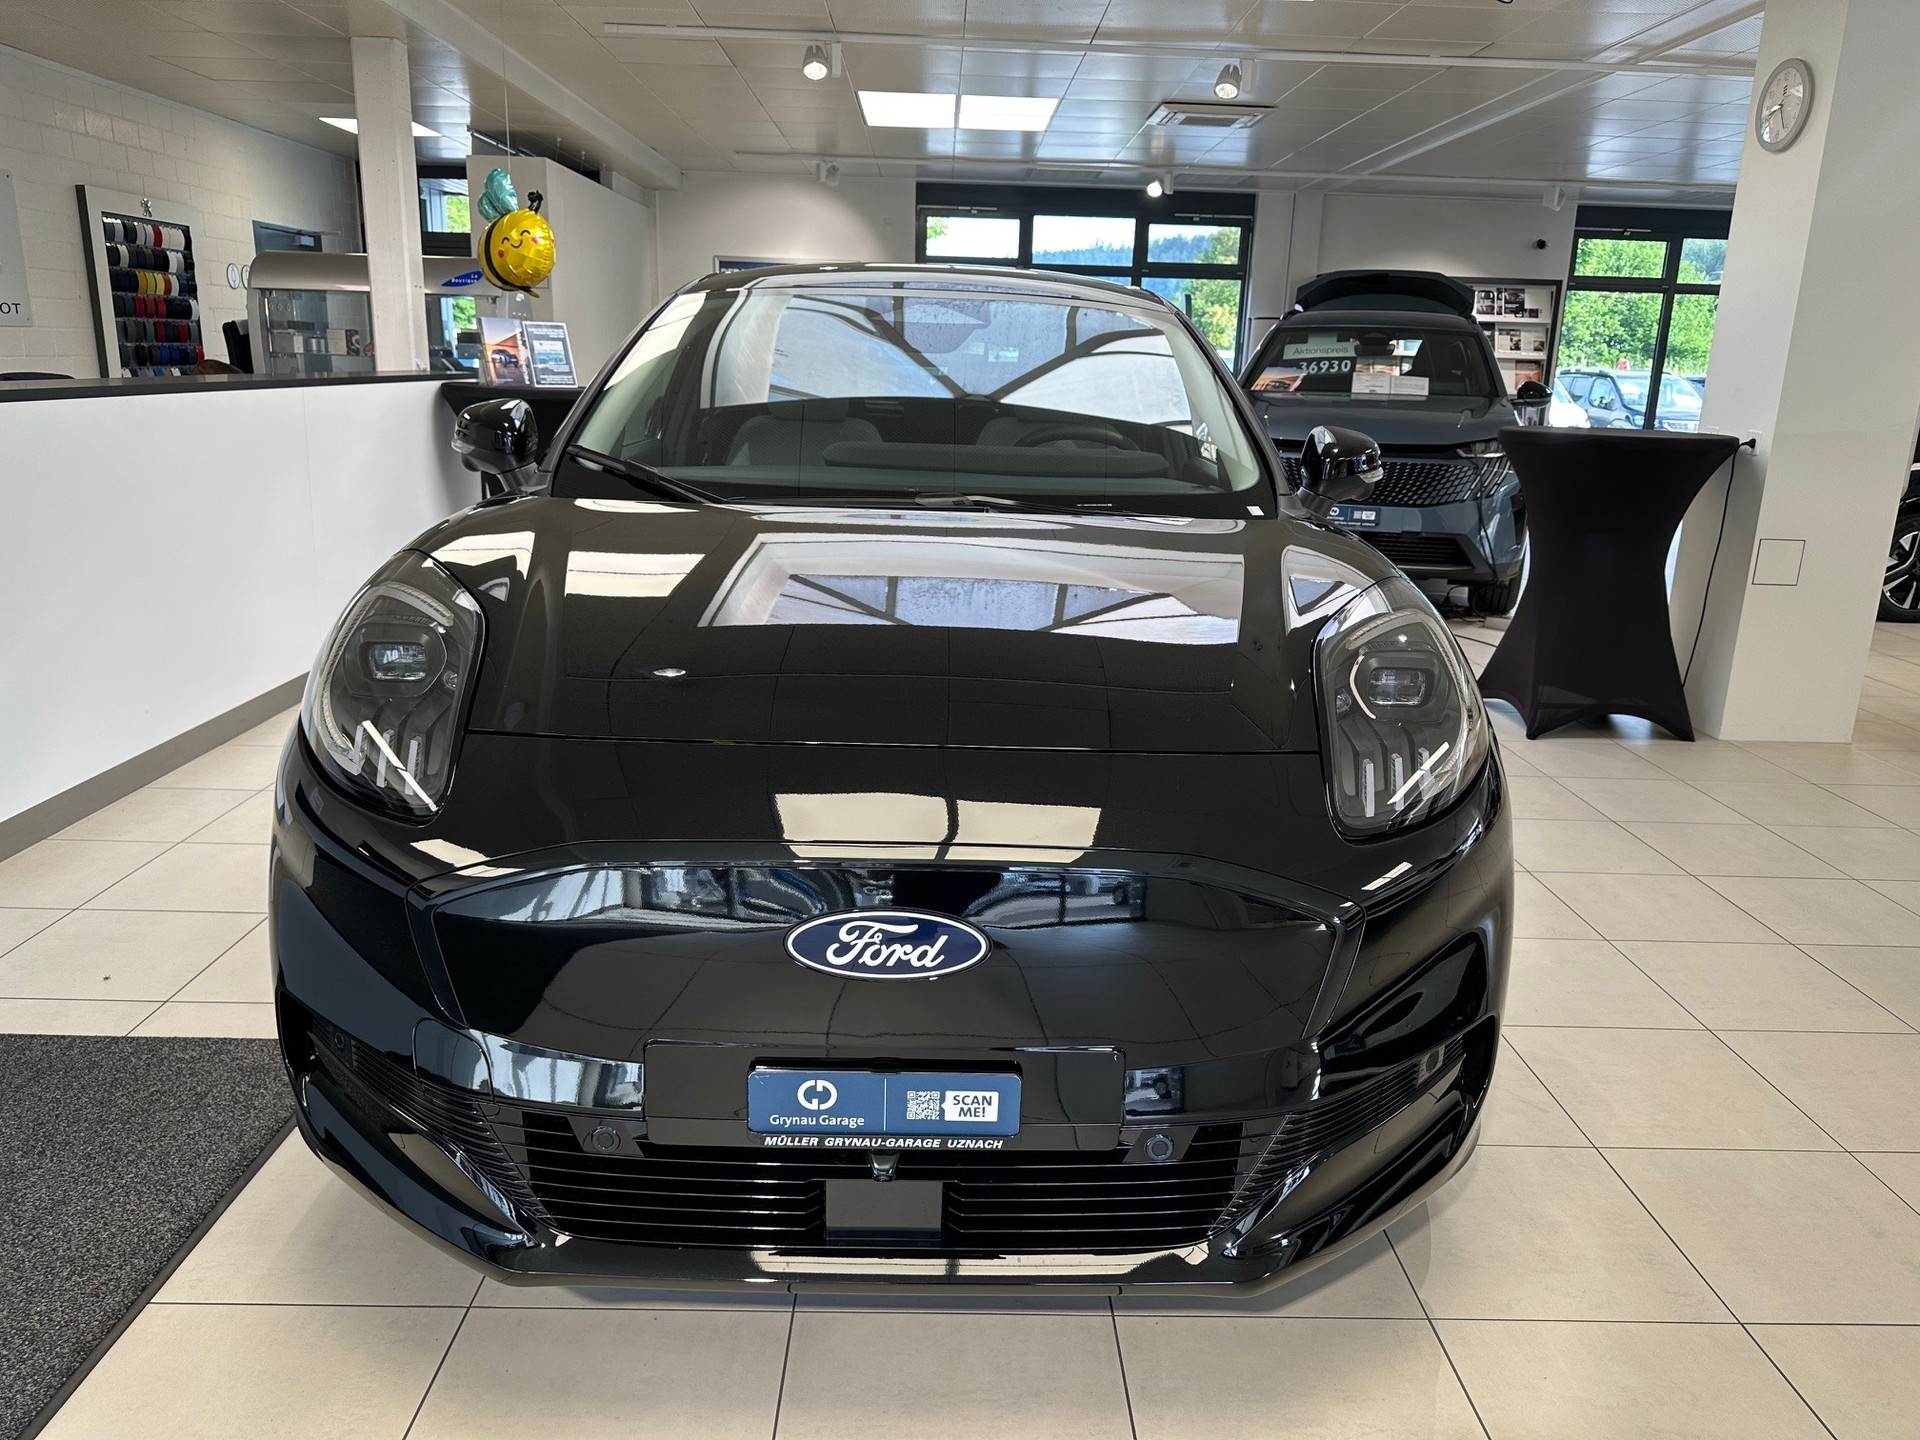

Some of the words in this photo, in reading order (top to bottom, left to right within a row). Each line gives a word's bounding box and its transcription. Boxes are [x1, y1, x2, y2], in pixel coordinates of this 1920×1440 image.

[1292, 346, 1349, 356] Aktionspreis
[1300, 359, 1351, 375] 36930
[826, 920, 949, 968] Ford
[952, 1094, 993, 1107] SCAN
[958, 1106, 986, 1118] ME!
[769, 1114, 816, 1128] Grynau
[819, 1115, 865, 1129] Garage
[764, 1135, 819, 1147] MÜLLER
[824, 1137, 942, 1149] GRYNAU-GARAGE
[947, 1139, 1003, 1149] UZNACH
